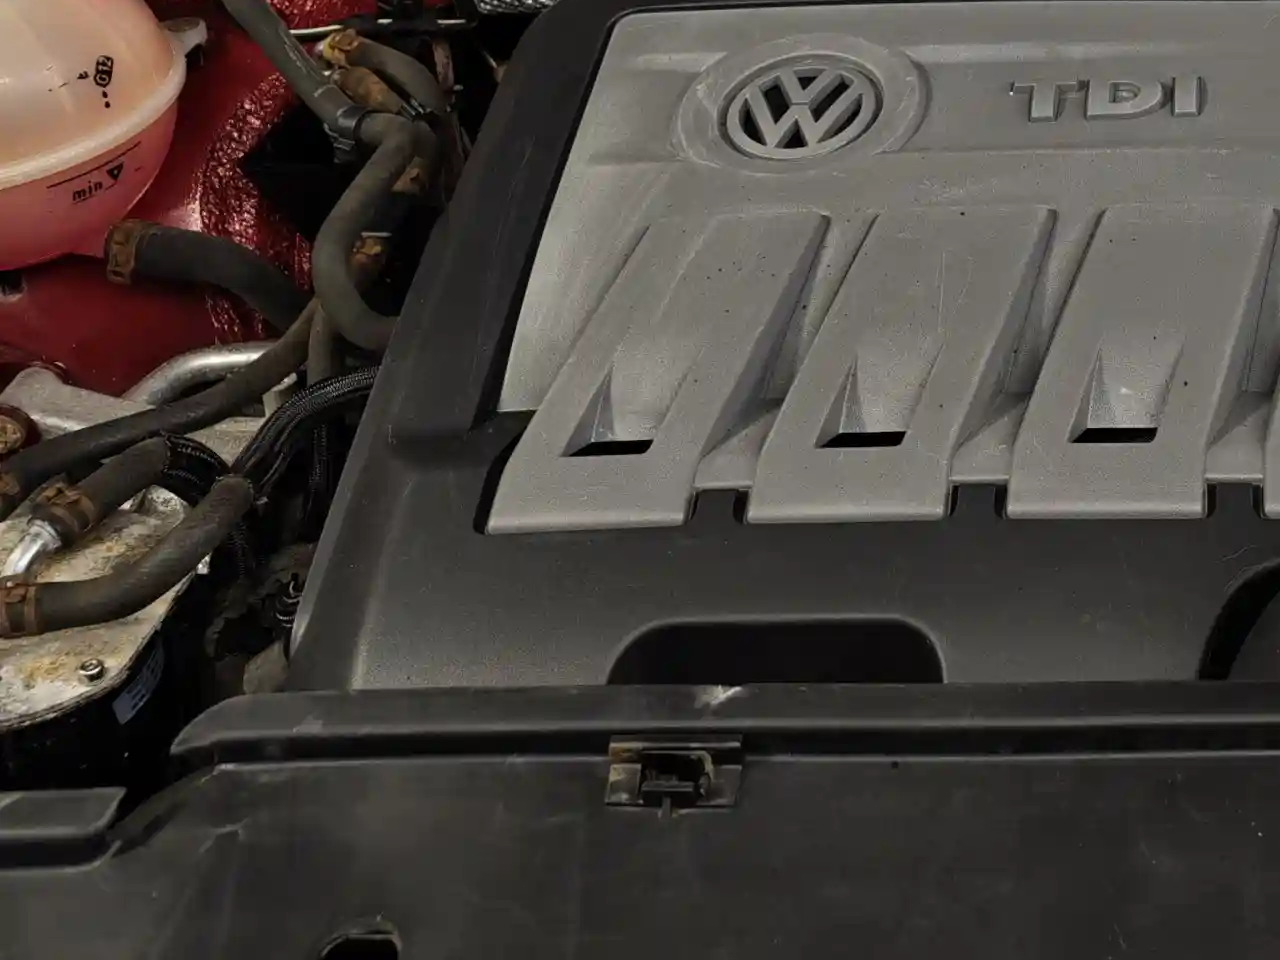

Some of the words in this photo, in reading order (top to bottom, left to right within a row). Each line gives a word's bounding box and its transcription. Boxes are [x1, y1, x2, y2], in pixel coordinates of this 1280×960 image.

[729, 65, 875, 158] VW
[1010, 75, 1207, 122] TDI
[72, 180, 103, 202] min
